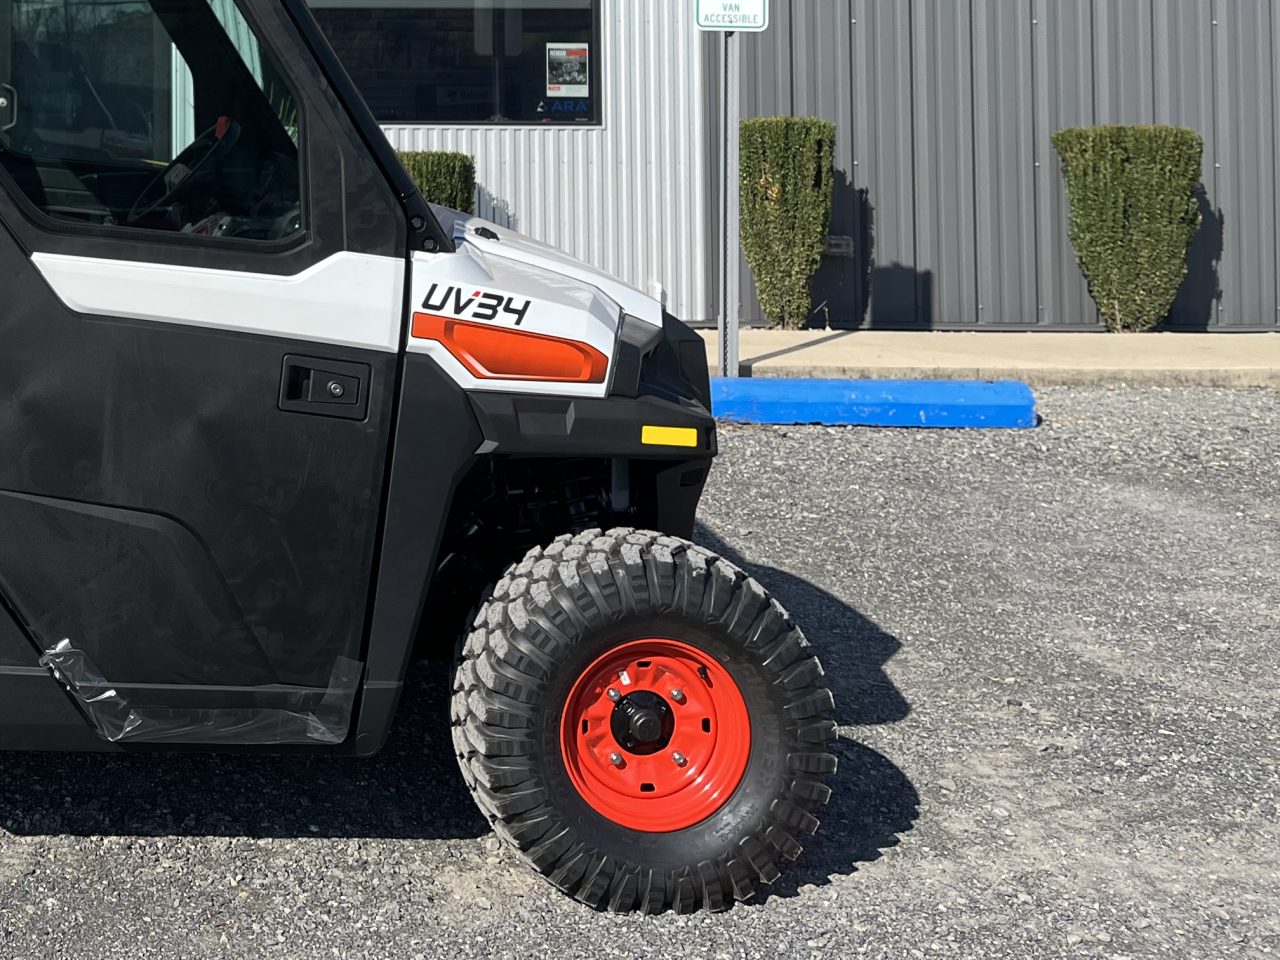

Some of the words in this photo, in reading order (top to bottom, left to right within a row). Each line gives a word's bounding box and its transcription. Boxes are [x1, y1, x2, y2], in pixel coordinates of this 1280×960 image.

[722, 3, 740, 13] VAN
[704, 13, 759, 24] ACCESSIBLE
[421, 283, 532, 326] UV34
